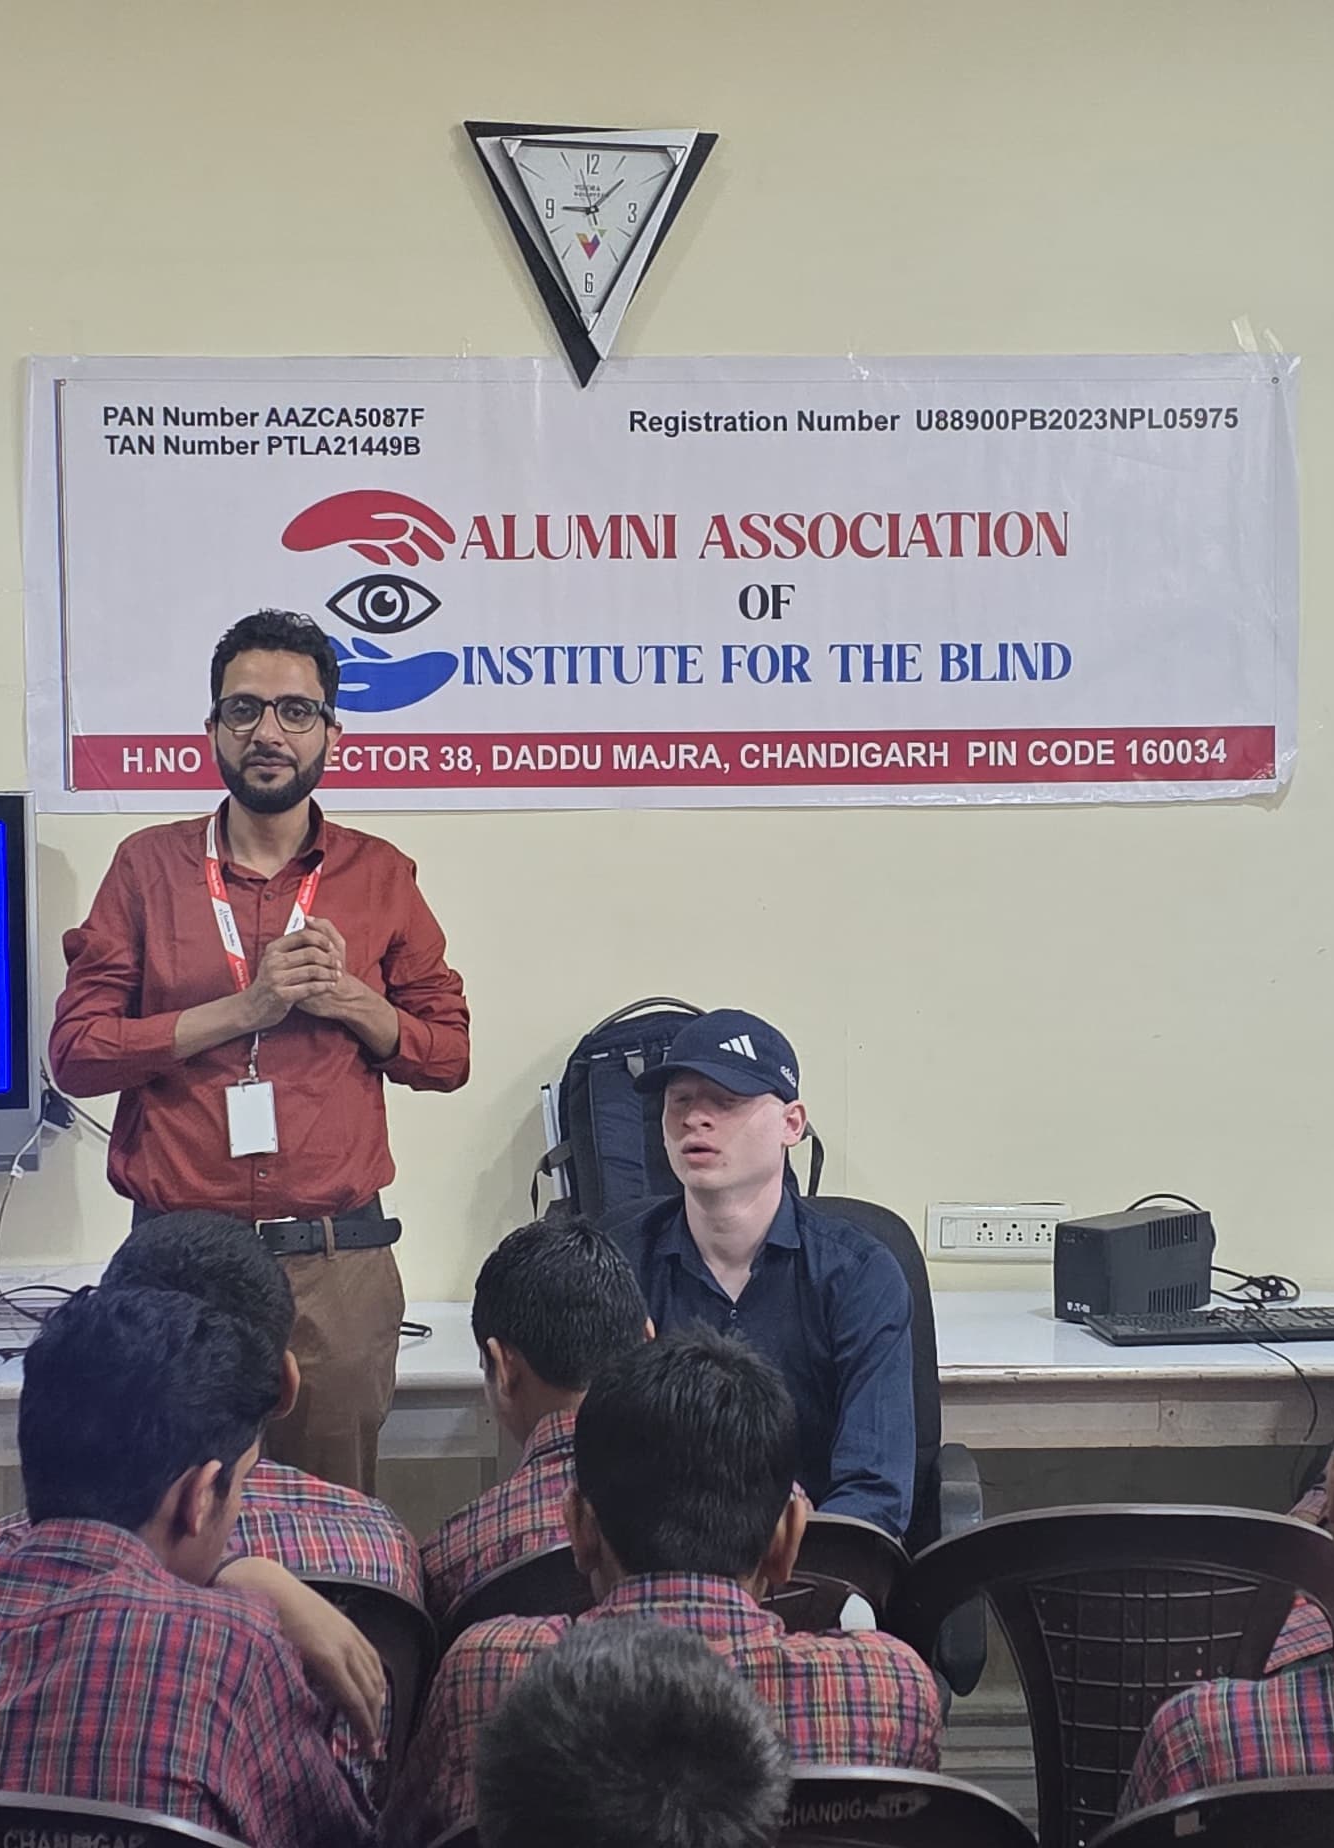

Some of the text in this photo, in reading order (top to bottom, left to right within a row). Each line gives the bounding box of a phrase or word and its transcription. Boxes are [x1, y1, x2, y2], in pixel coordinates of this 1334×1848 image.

[586, 153, 600, 175] 12
[545, 198, 555, 219] 9
[627, 202, 637, 223] 3
[584, 272, 594, 293] 6
[103, 406, 425, 428] PAN Number AAZCA5087F
[629, 407, 1239, 438] Registration Number U88900PB2023NPL05975
[104, 434, 421, 457] TAN Number PTLA21449B
[460, 510, 1069, 561] ALUMNI ASSOCIATION
[738, 583, 796, 621] OF
[462, 641, 1072, 686] INSTITUTE FOR THE BLIND
[323, 744, 431, 772] ECTOR
[439, 745, 481, 777] 38,
[492, 744, 602, 771] DADDU
[612, 743, 730, 775] MAJRA,
[740, 741, 949, 769] CHANDIGARH
[968, 740, 1017, 767] PIN
[1027, 739, 1116, 766] CODE
[1125, 738, 1228, 765] 160034
